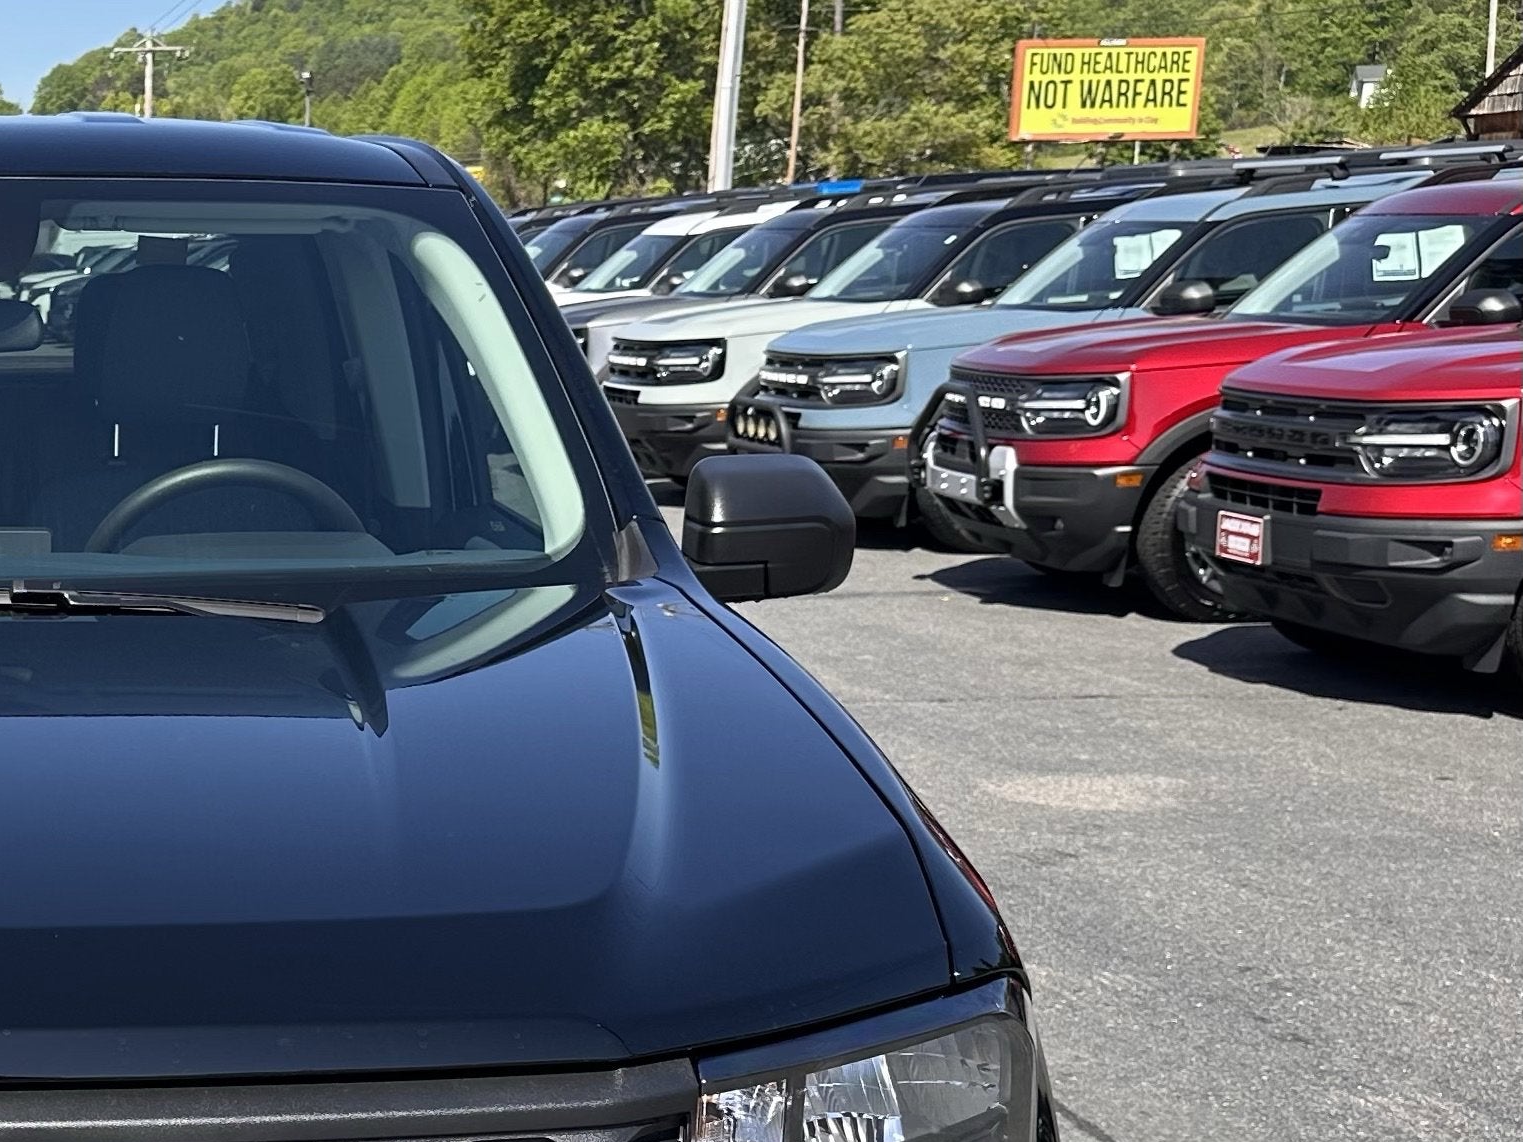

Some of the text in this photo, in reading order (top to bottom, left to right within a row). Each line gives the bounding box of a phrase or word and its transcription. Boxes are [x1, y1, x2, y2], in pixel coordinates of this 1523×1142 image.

[1029, 50, 1192, 75] FUND HEALTHCARE
[1026, 78, 1190, 109] NOT WARFARE
